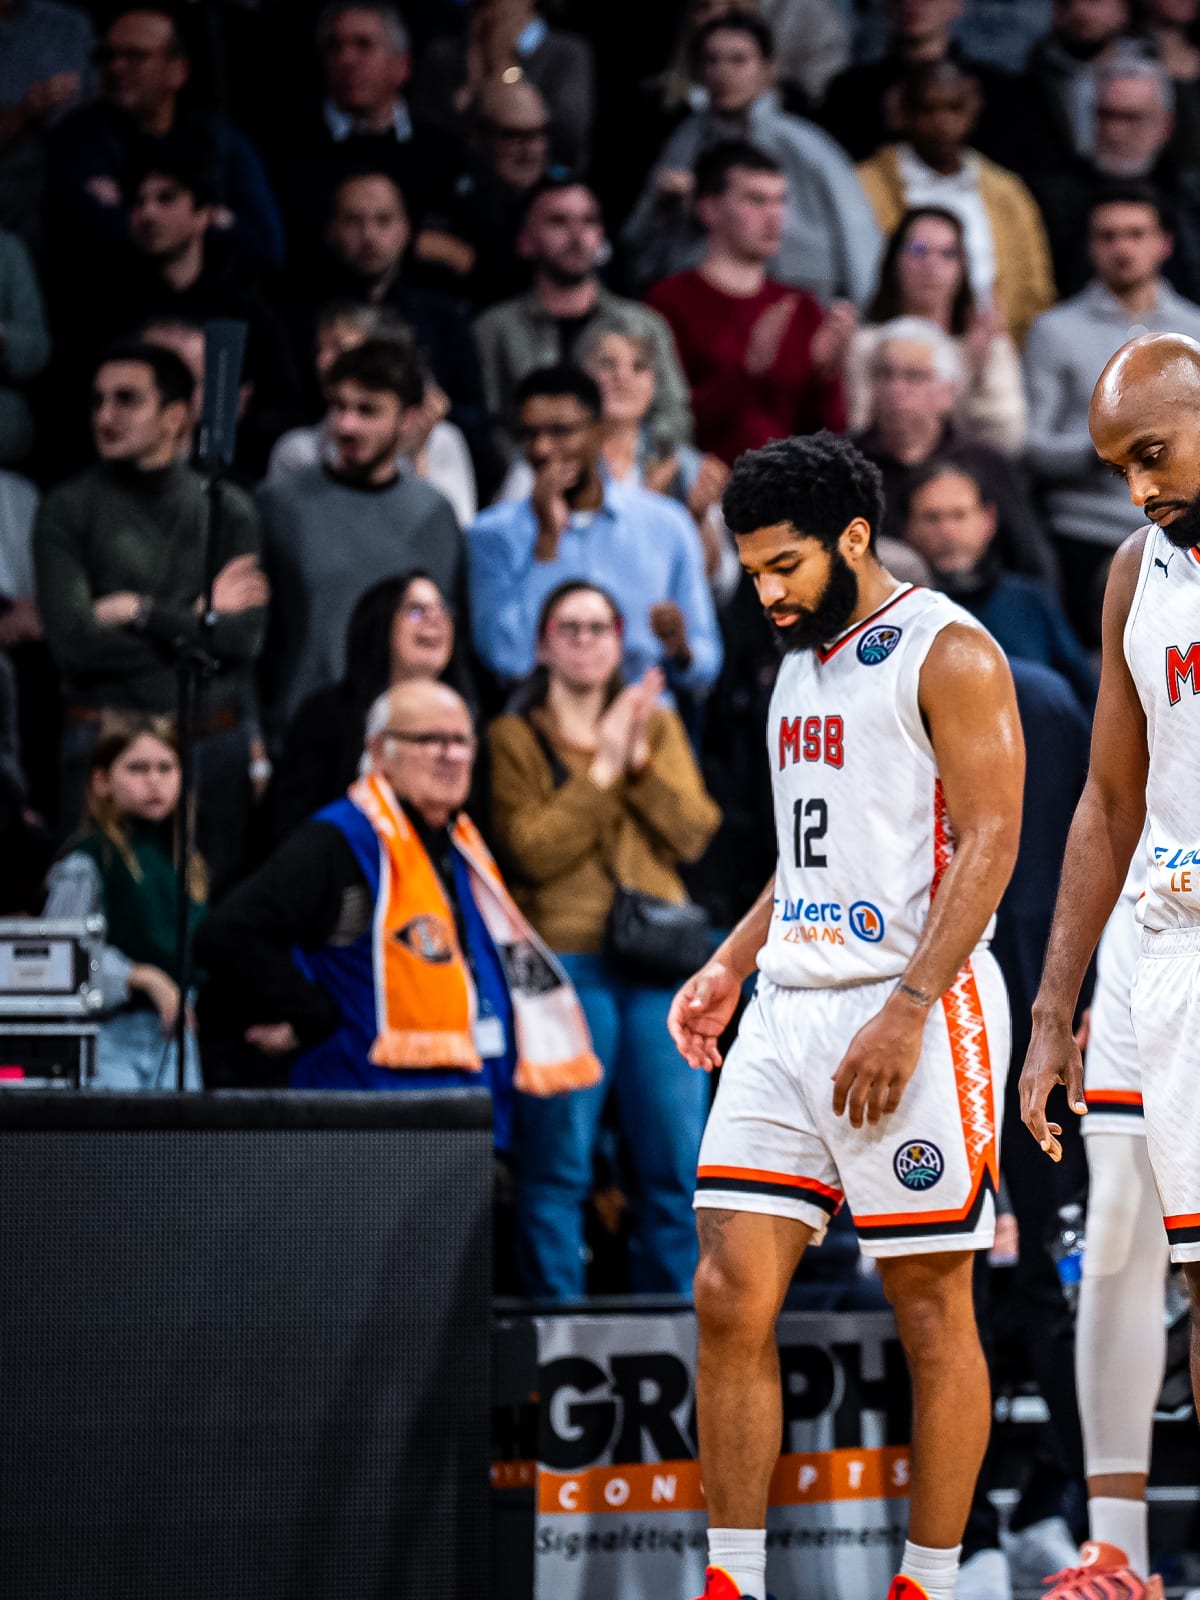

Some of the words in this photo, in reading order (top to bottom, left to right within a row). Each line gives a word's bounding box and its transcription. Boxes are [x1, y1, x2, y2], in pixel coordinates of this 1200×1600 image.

[779, 715, 844, 771] MSB
[793, 798, 828, 868] 12
[1170, 871, 1192, 892] LE
[536, 1343, 912, 1470] GRPH
[558, 1458, 911, 1509] CONPTS
